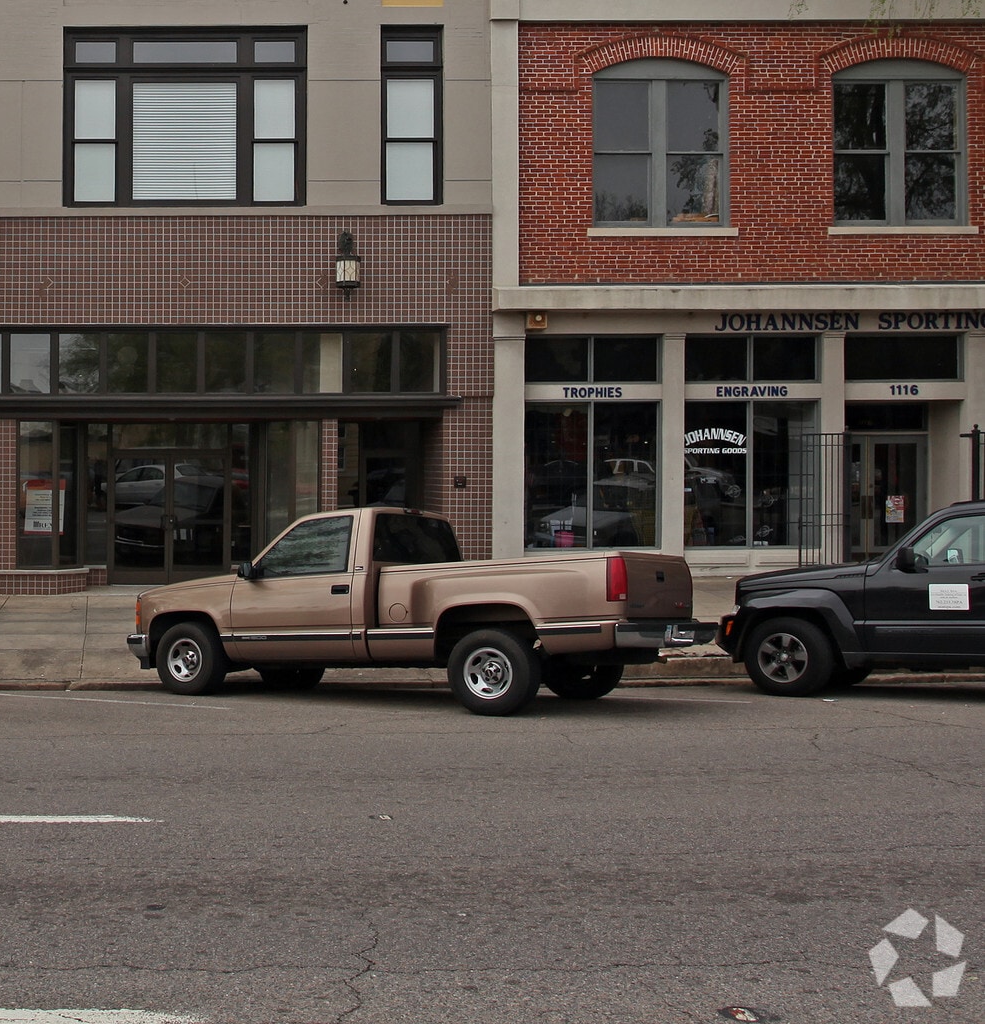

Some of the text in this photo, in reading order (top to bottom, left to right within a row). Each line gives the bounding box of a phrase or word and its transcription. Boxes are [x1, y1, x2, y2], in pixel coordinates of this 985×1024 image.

[715, 311, 985, 331] JOHANNSEN SPORTIN
[563, 387, 623, 398] TROPHIES
[716, 386, 788, 397] ENGRAVING
[890, 384, 919, 395] 1116
[684, 428, 747, 446] JOHANNSEN
